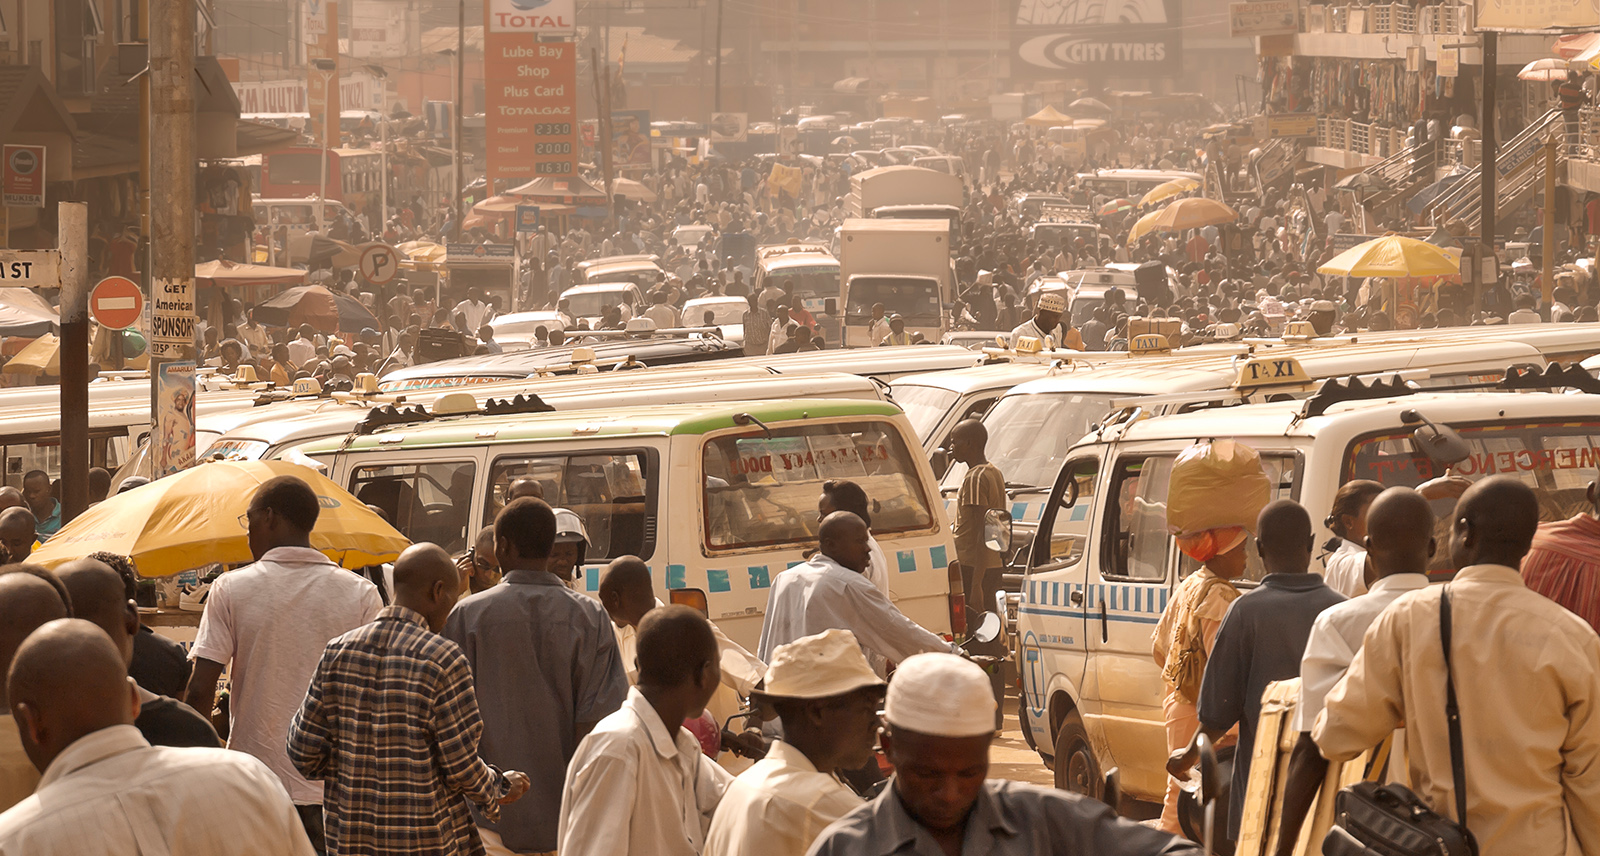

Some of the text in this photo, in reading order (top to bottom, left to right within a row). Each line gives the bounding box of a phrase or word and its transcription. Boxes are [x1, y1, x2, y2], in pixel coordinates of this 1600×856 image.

[495, 12, 571, 28] TOTAL
[502, 45, 563, 59] Lube Bay
[1071, 42, 1166, 62] CITY TYRES
[517, 65, 550, 79] Shop
[504, 84, 564, 97] Plus Card
[498, 106, 571, 115] TOTALGAZ
[497, 124, 570, 135] Premium 2350
[536, 143, 570, 154] 2000
[1506, 149, 1533, 170] CLINIC
[541, 162, 571, 173] 1630
[11, 262, 33, 279] ST
[164, 284, 187, 294] GET
[155, 298, 193, 311] American
[1018, 339, 1035, 350] TAXI
[1135, 337, 1159, 350] TAXI
[1247, 360, 1296, 380] TAXI
